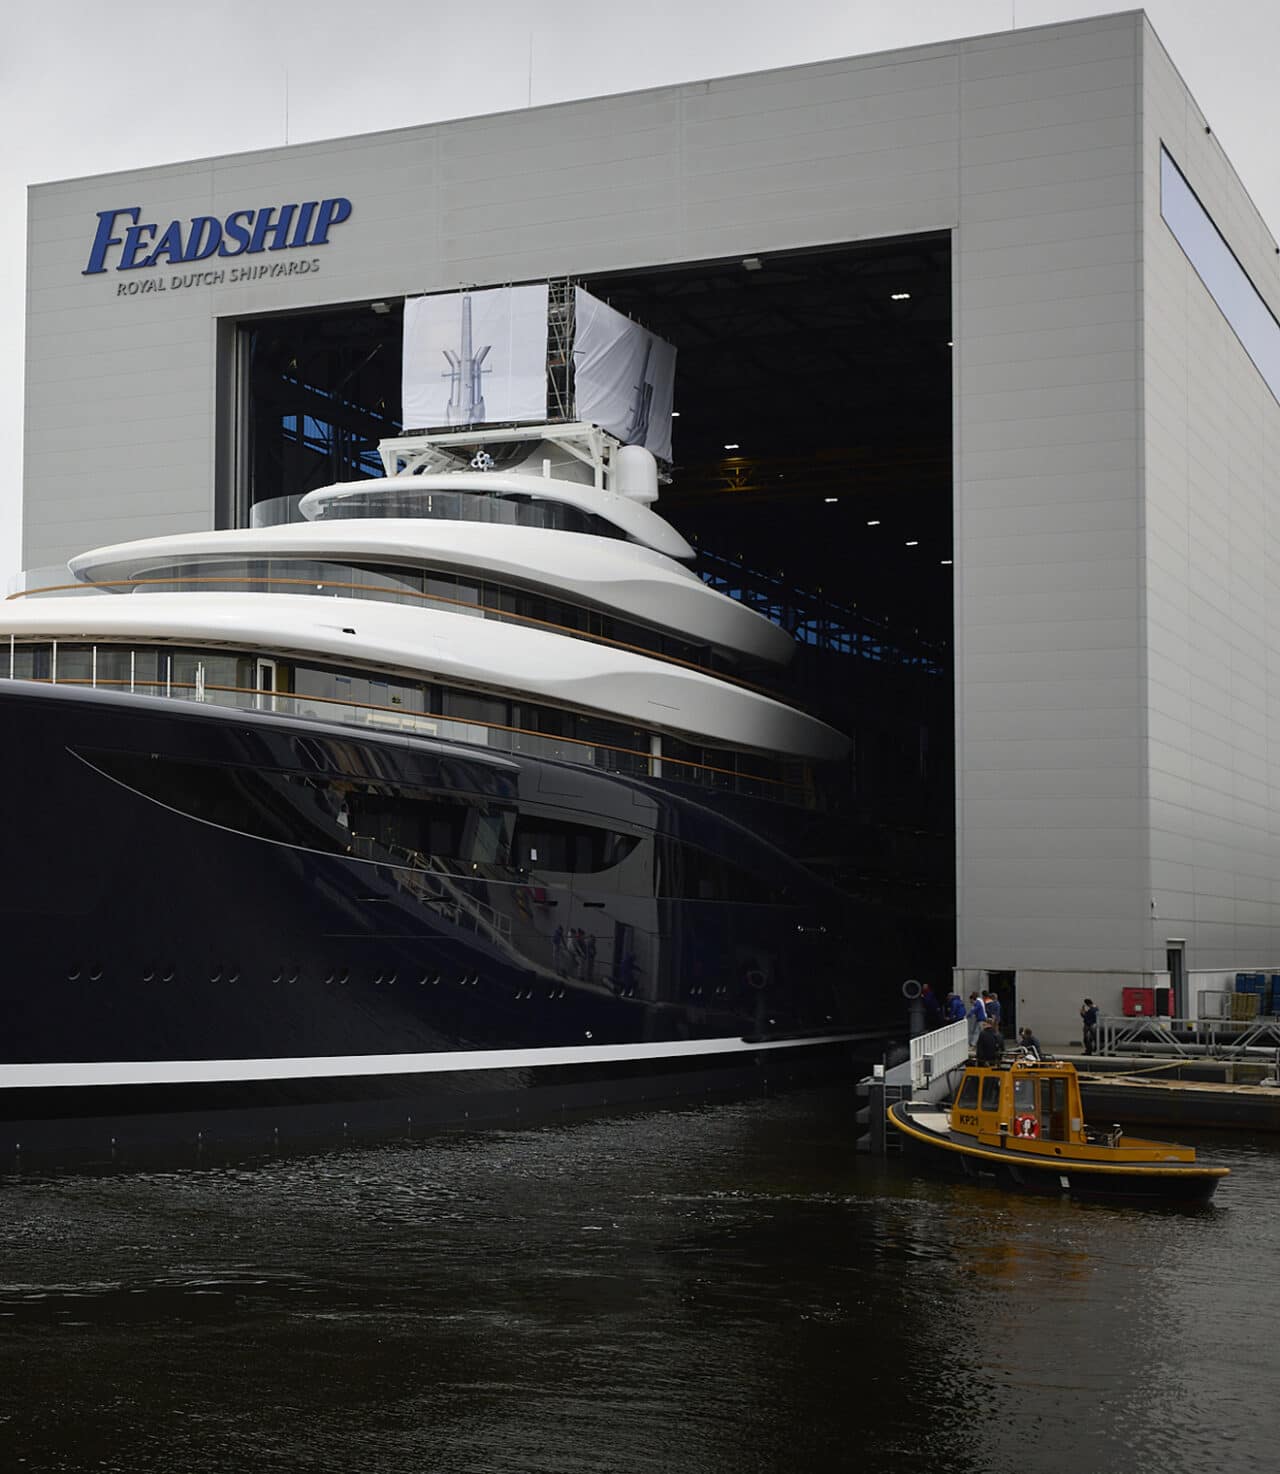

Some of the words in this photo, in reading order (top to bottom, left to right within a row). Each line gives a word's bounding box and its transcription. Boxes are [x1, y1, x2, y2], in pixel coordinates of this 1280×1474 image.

[81, 197, 352, 275] FEADSHIP
[117, 278, 166, 296] ROYAL
[171, 270, 225, 290] DUTCH
[229, 258, 320, 282] SHIPYARDS
